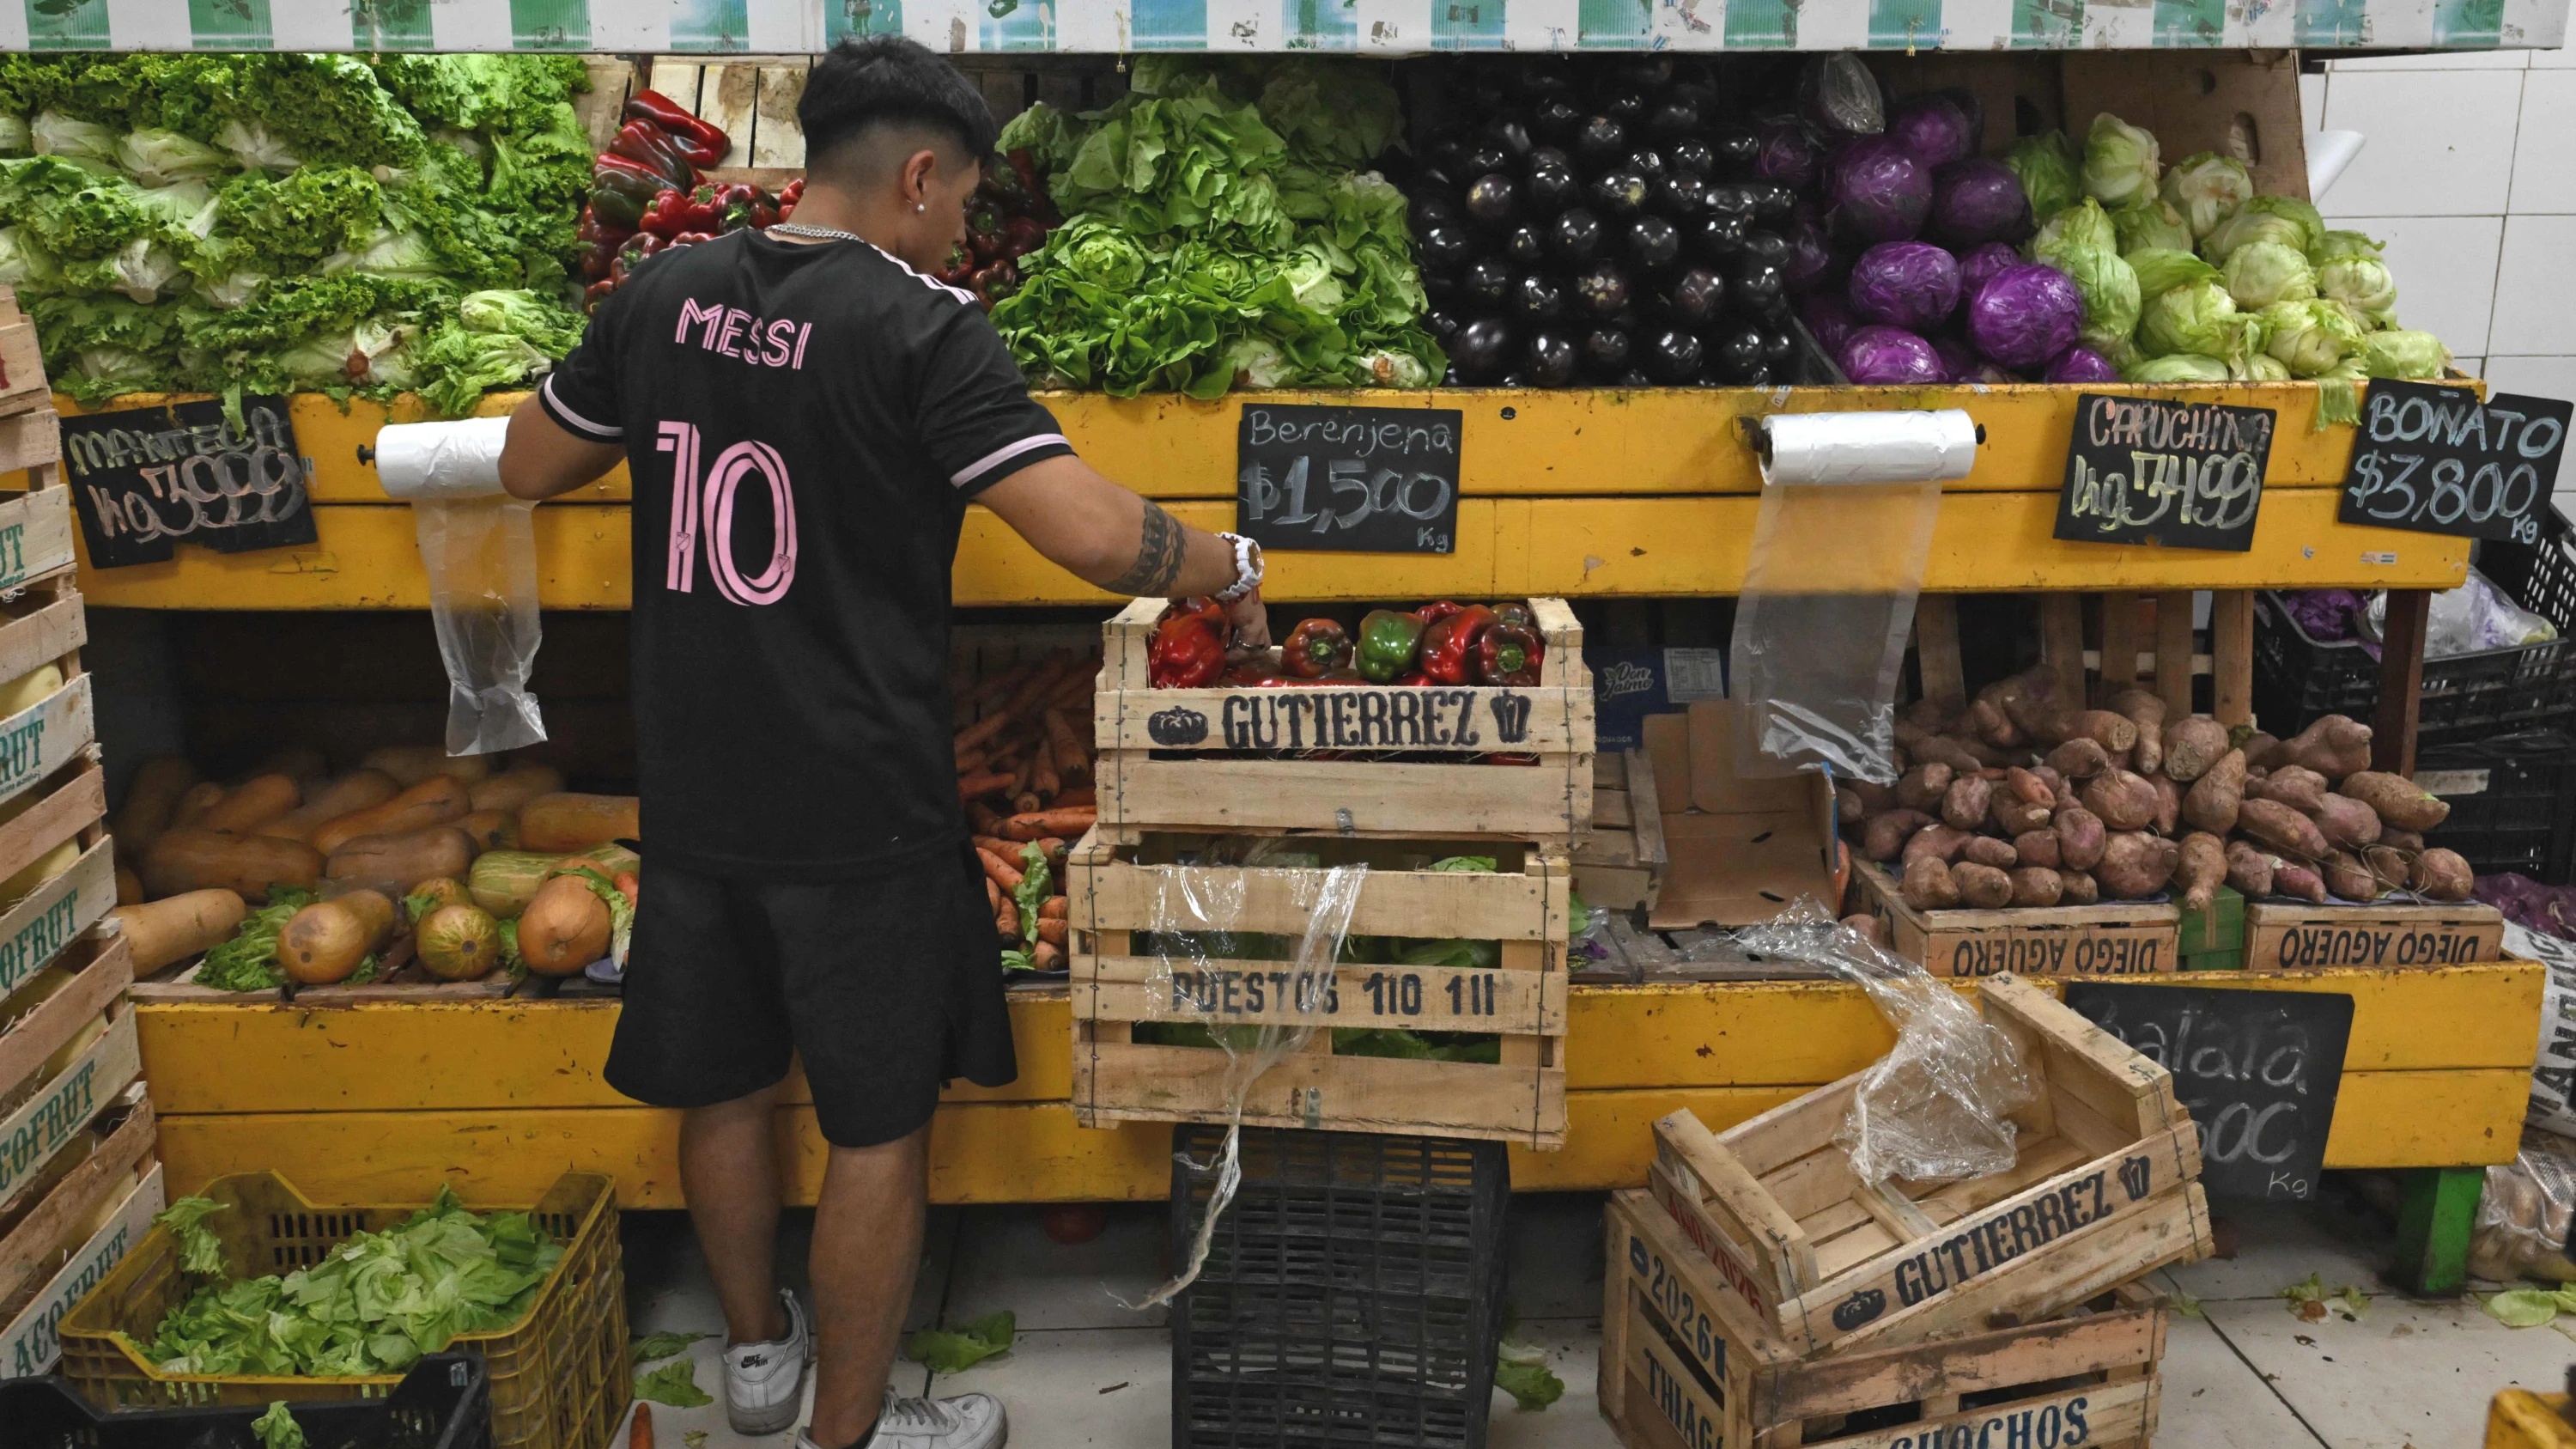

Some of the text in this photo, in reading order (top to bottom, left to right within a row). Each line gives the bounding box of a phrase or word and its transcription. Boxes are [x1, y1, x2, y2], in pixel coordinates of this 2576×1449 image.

[675, 297, 812, 369] MESSI
[1249, 410, 1453, 458] Berenjena
[2368, 390, 2563, 459] BOÑATO
[657, 421, 798, 606] 10
[1222, 690, 1481, 749] GUTIERREZ
[1953, 938, 2159, 977] DIEGO AGUERO
[2279, 928, 2480, 969] DIEGO AGUERO
[1172, 971, 1340, 1014] PUESTOS
[2267, 1171, 2308, 1198] Kg
[1894, 1169, 2114, 1307] GUTIERREZ
